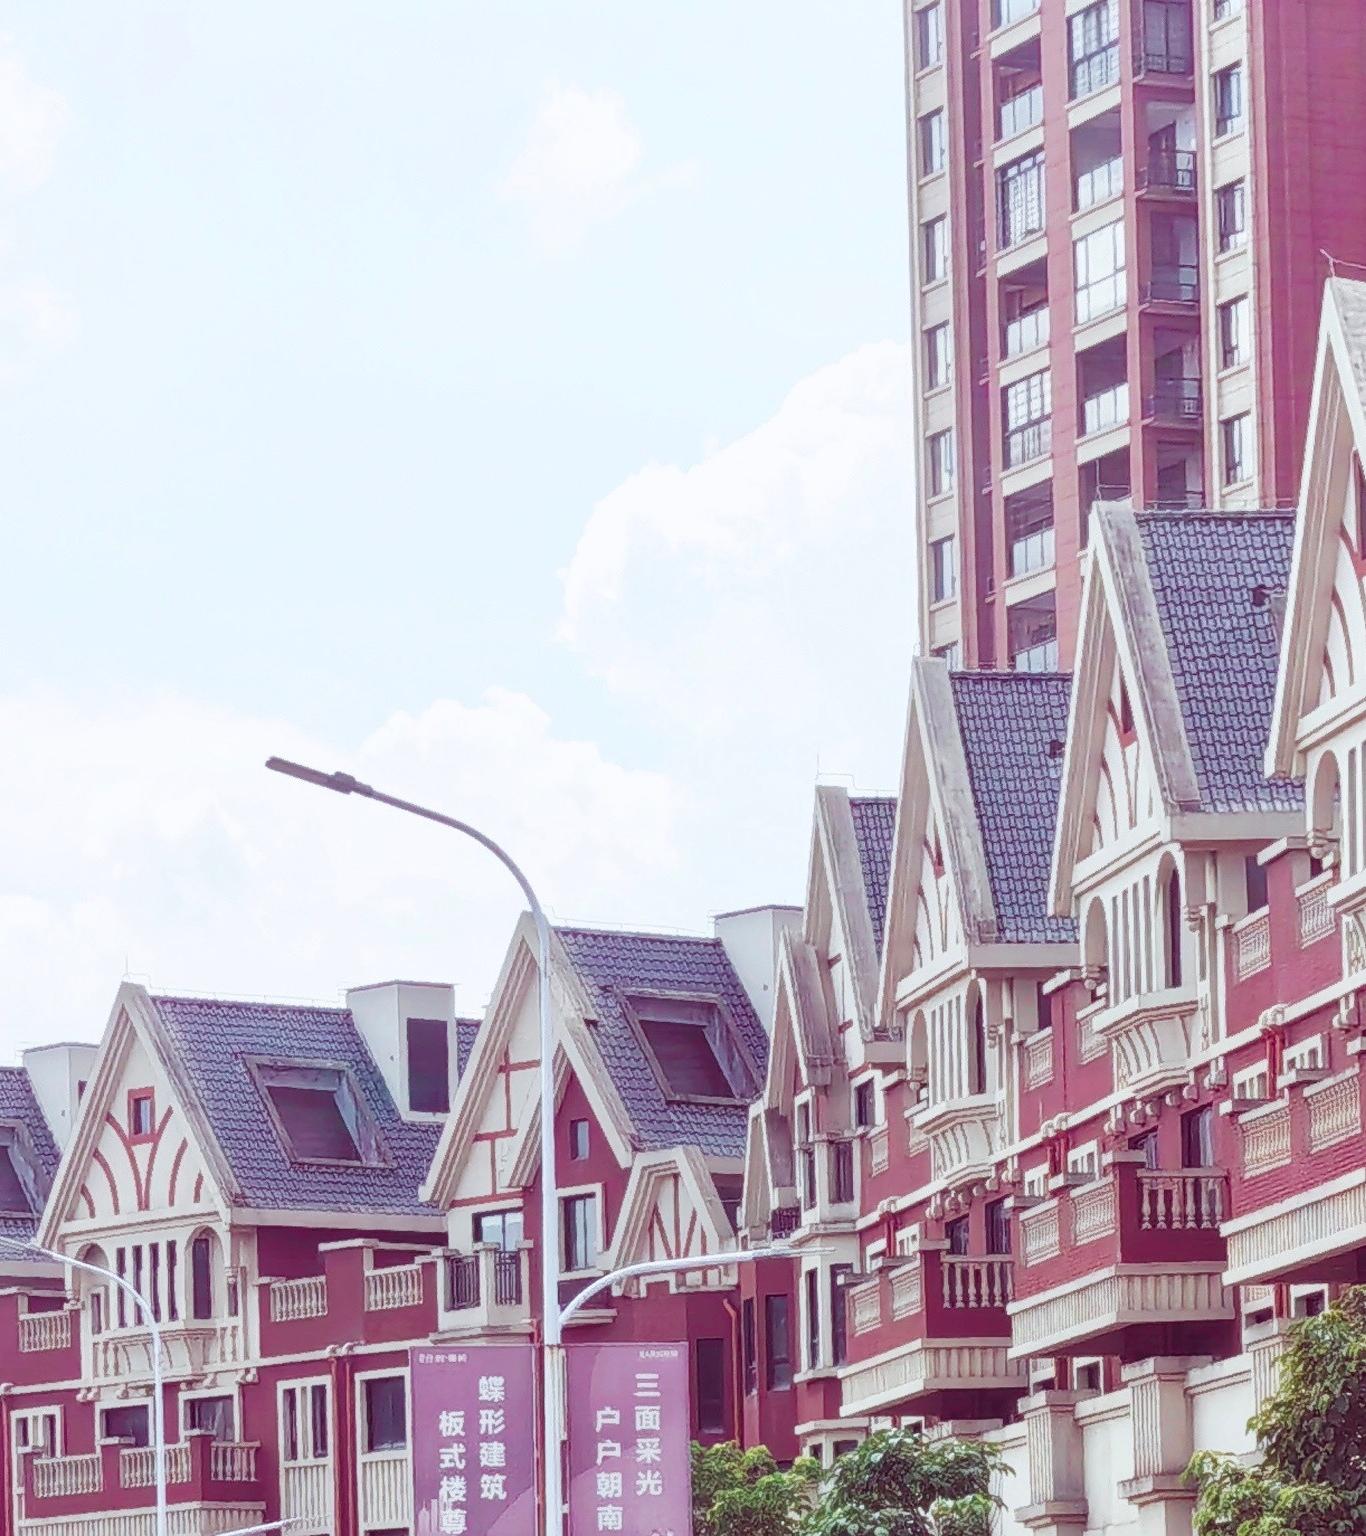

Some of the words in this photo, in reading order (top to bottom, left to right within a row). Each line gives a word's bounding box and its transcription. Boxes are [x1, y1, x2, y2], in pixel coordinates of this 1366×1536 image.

[477, 1375, 507, 1500] 蝶形建筑
[595, 1406, 623, 1531] 户户朝南
[633, 1373, 663, 1496] 三面采光
